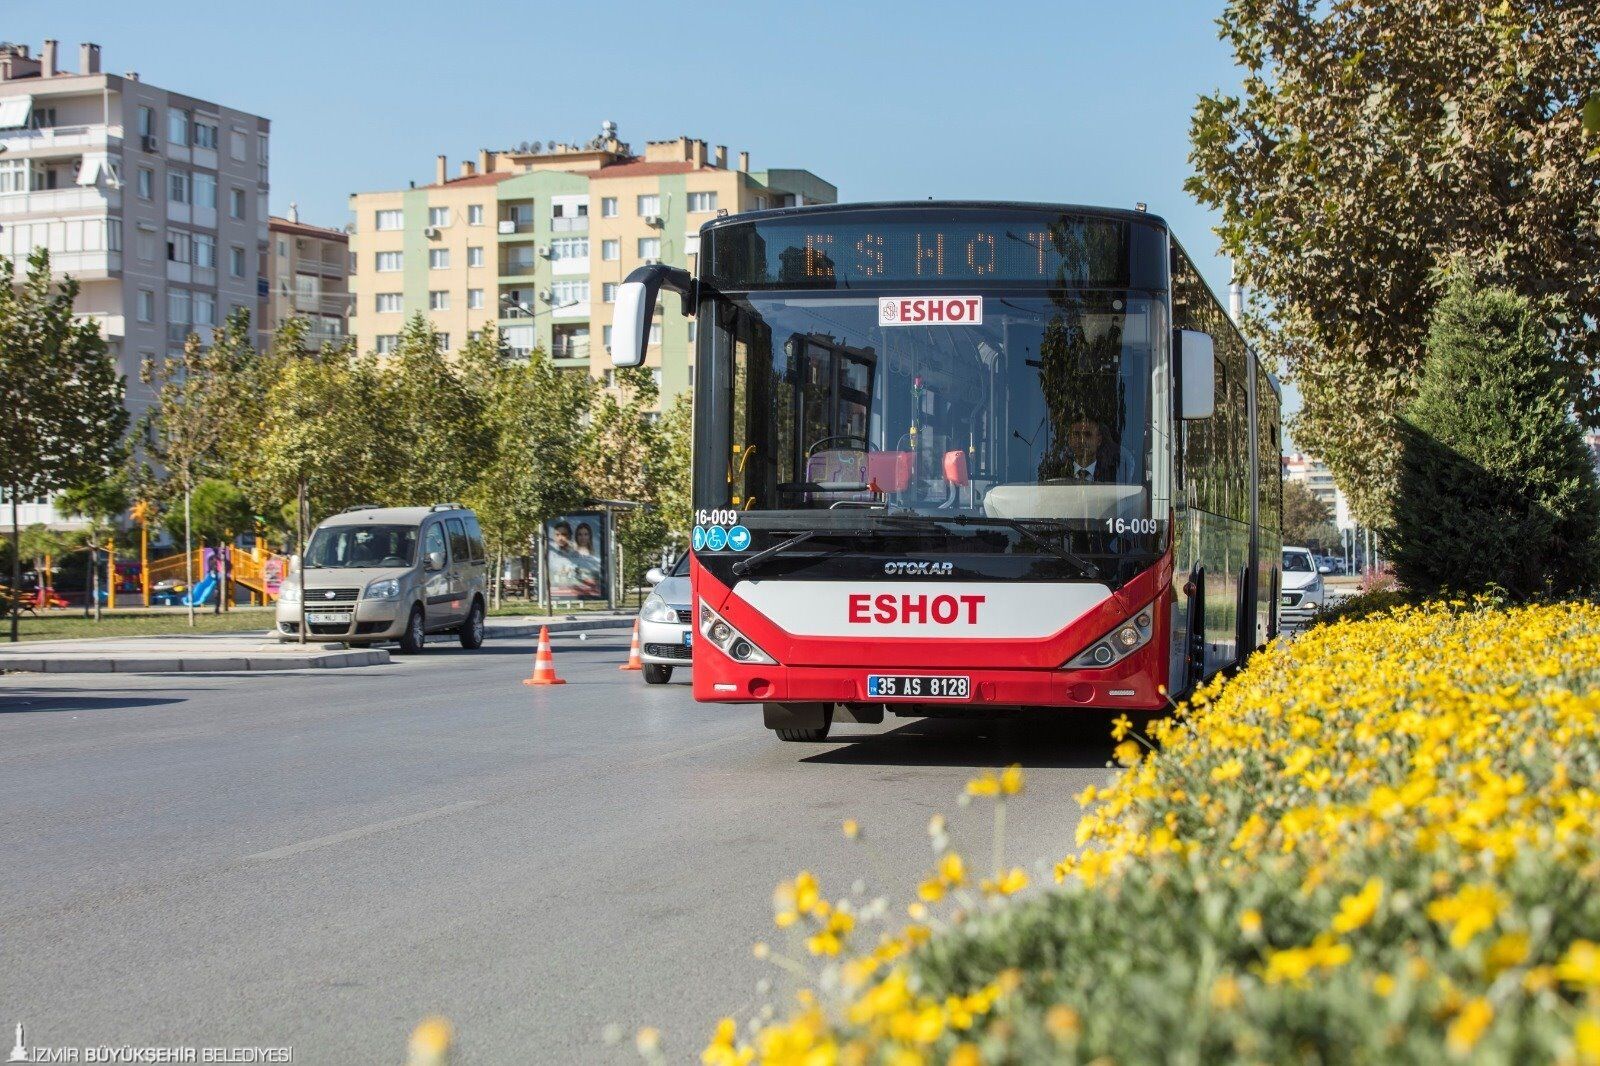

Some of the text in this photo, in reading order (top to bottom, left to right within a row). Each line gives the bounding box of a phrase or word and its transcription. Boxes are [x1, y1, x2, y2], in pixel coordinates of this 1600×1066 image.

[807, 233, 1053, 276] ESHOT
[900, 300, 978, 321] ESHOT
[694, 509, 737, 525] 16-009
[1106, 517, 1157, 534] 16-009
[884, 561, 954, 575] OTOKAR
[849, 594, 986, 625] ESHOT
[878, 678, 896, 695] 35
[903, 678, 921, 695] AS
[930, 679, 967, 696] 8128
